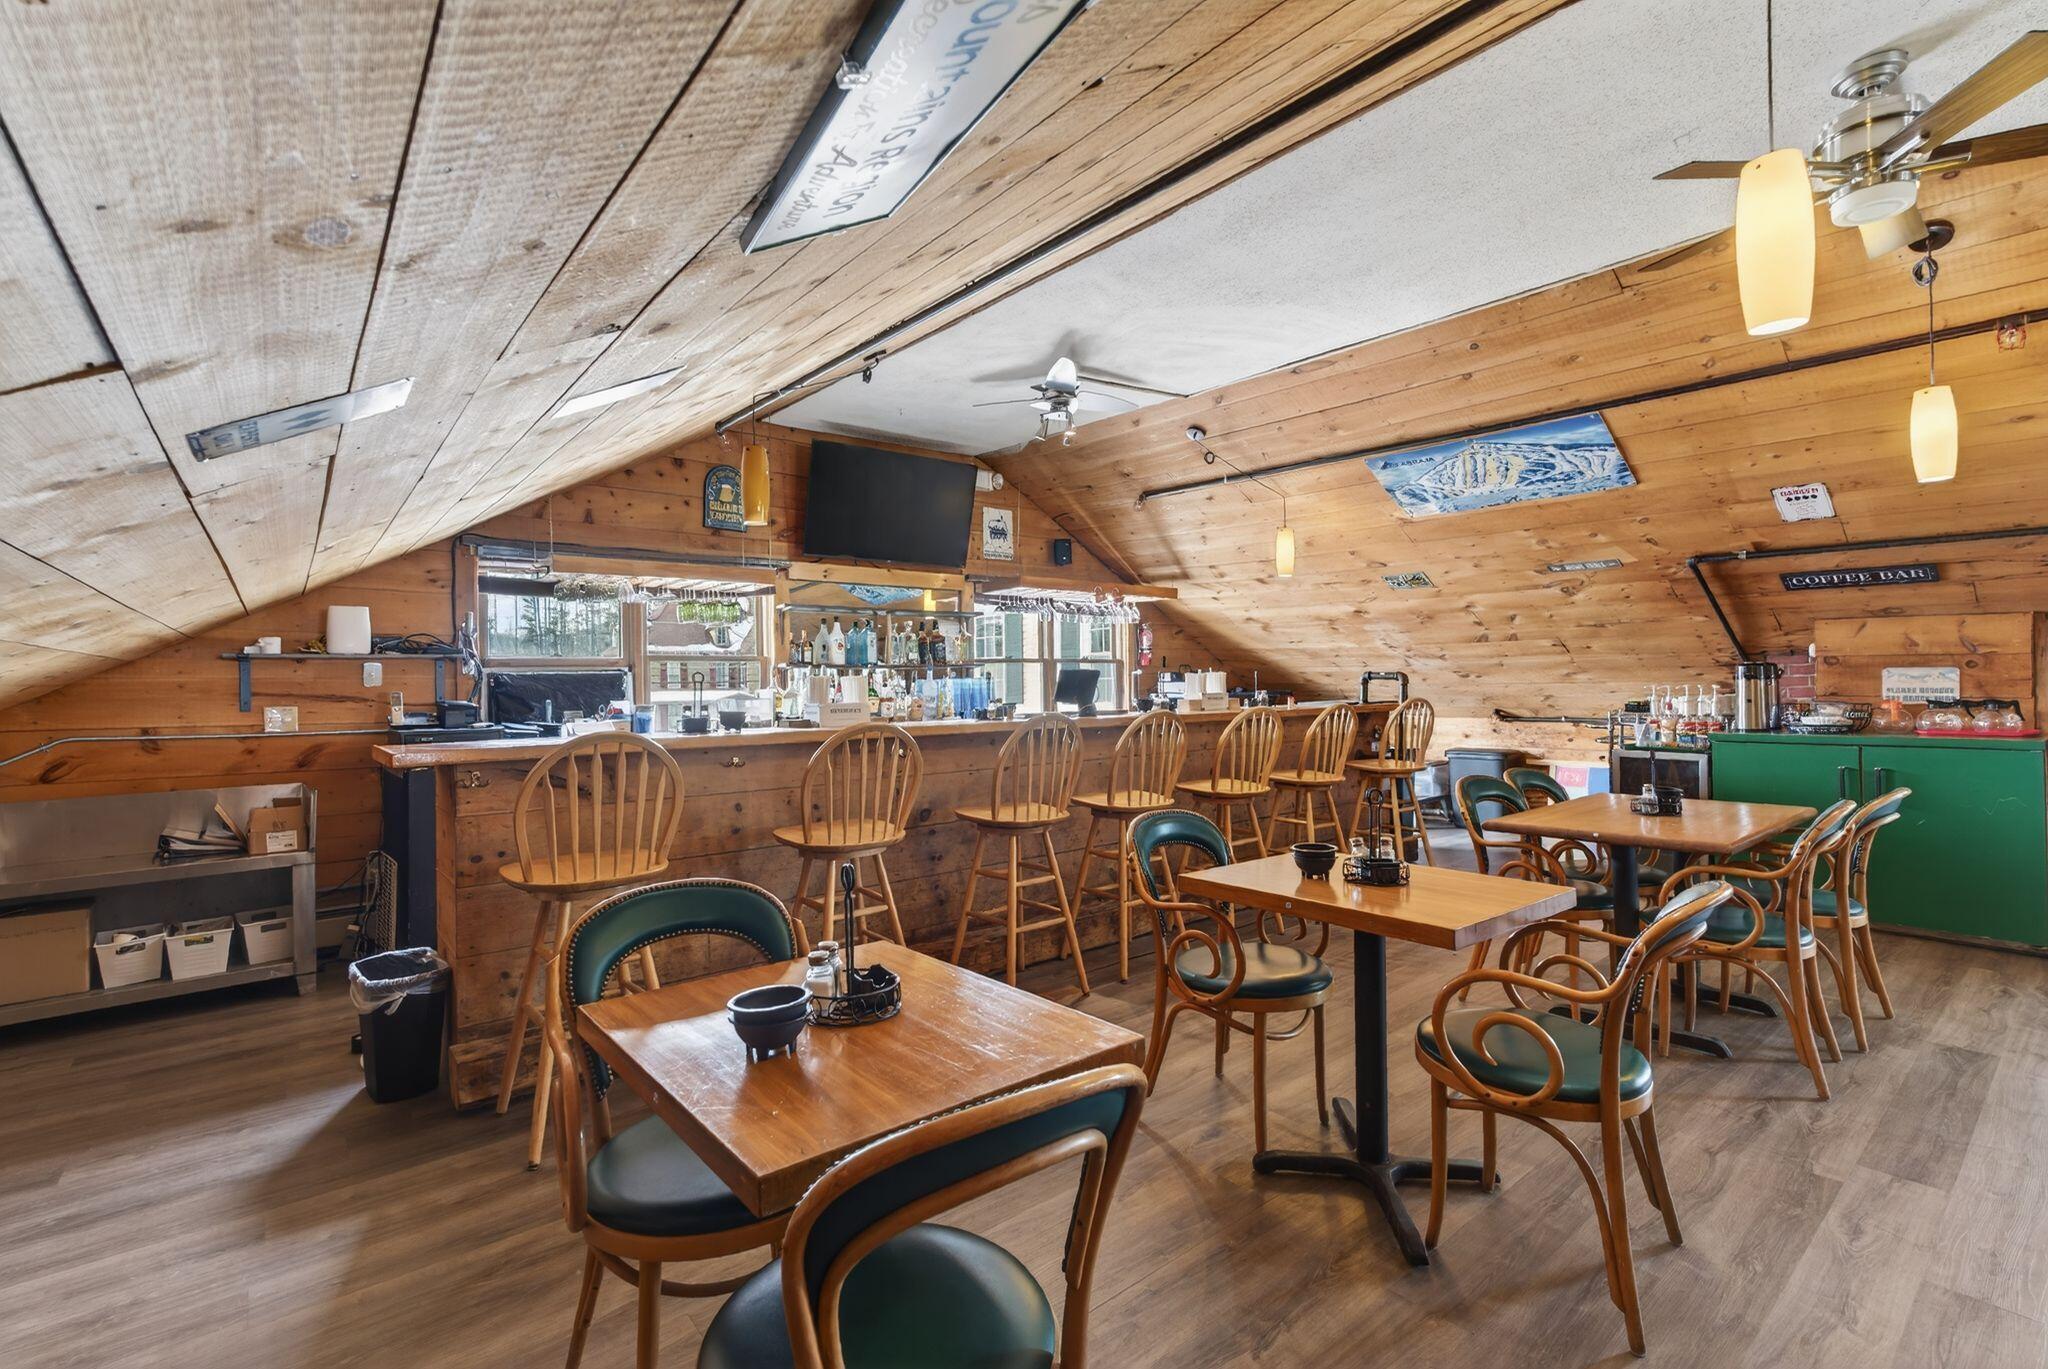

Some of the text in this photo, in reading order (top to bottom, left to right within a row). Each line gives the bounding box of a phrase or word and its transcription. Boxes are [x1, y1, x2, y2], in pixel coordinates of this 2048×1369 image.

[855, 0, 975, 125] ecreation
[882, 0, 1018, 147] ountains
[1791, 569, 1926, 586] COFFEE BAR
